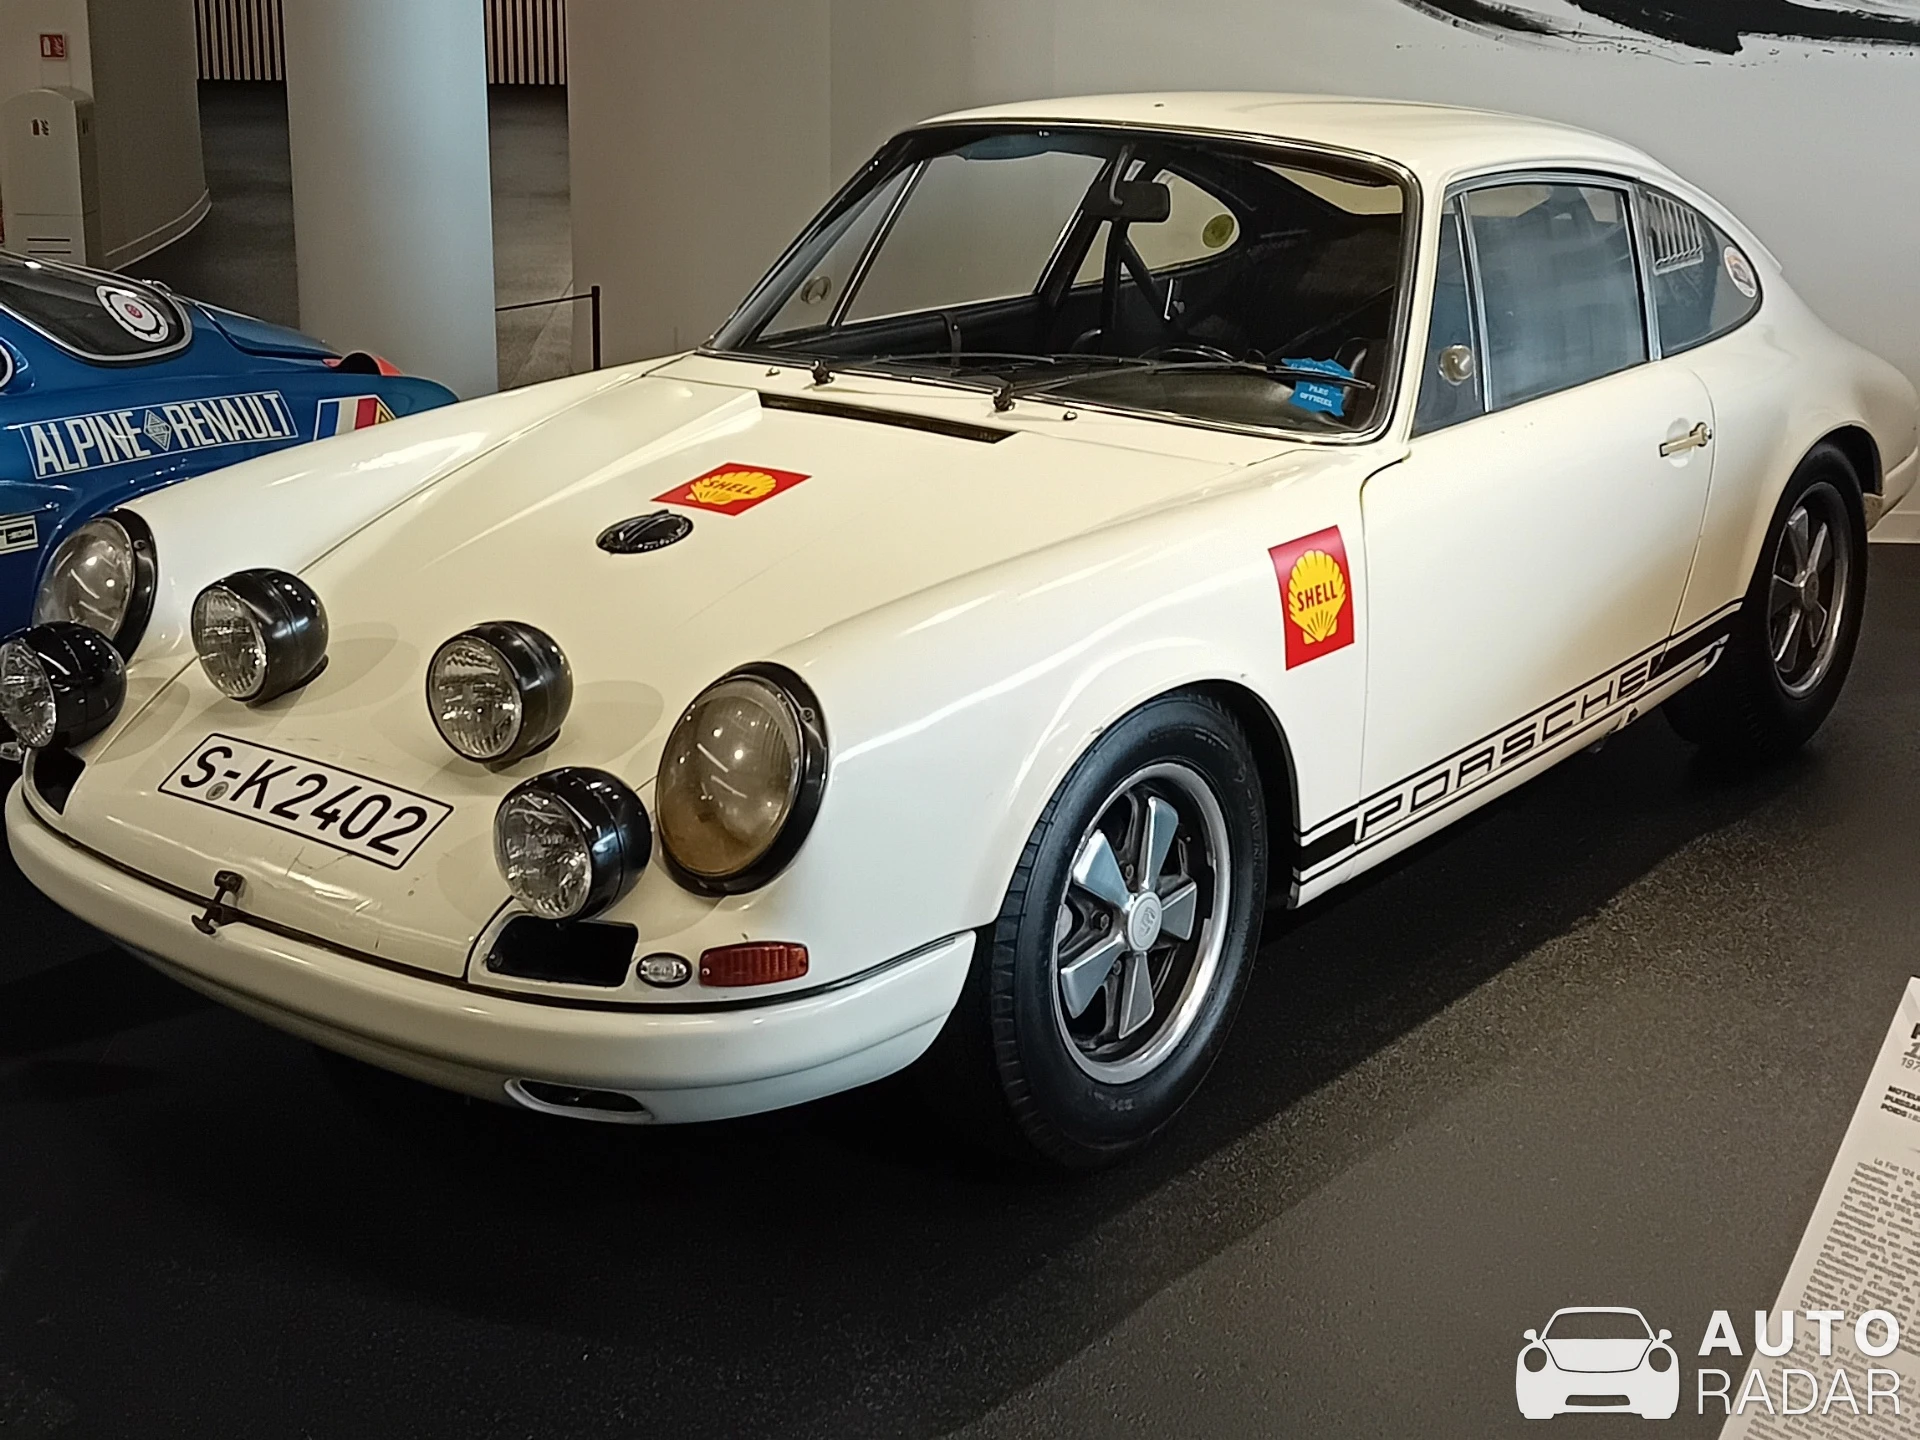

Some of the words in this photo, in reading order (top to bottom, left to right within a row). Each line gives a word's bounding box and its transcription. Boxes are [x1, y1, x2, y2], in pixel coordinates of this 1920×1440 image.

[30, 411, 151, 475] ALPINE
[161, 393, 292, 449] RENAULT
[703, 480, 757, 495] SHELL
[1297, 580, 1337, 612] SHELL
[1358, 655, 1650, 840] PORSCHE
[180, 746, 428, 856] S-K2402
[1901, 1057, 1920, 1073] 197
